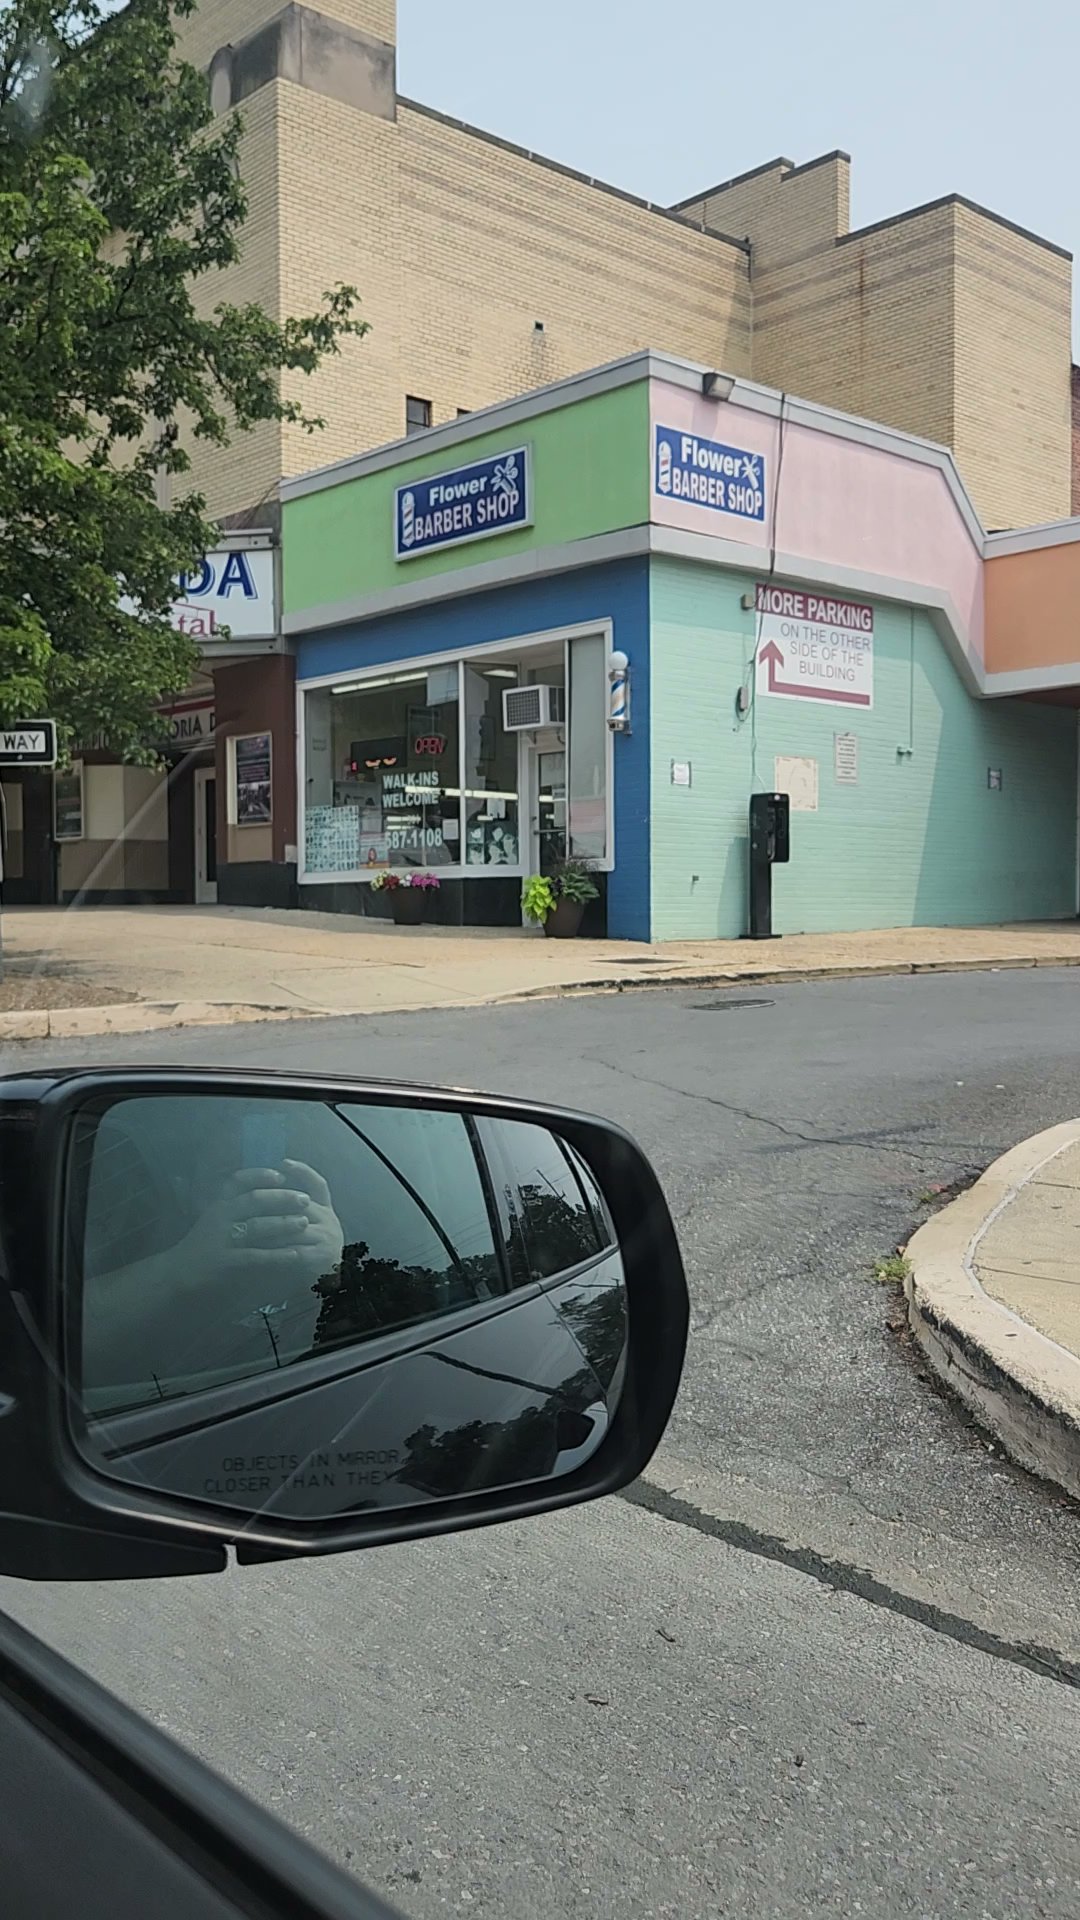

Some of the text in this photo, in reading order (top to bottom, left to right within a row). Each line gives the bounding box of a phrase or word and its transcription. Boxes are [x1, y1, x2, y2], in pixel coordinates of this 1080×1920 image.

[681, 436, 742, 478] Flower
[429, 476, 488, 507] Flower
[672, 467, 762, 516] BARBER SHOP
[415, 489, 519, 541] BARBER SHOP
[179, 552, 258, 600] DA
[758, 587, 871, 630] MORE PARKING
[177, 609, 215, 637] tal
[781, 622, 871, 651] ON THE OTHER
[790, 641, 864, 667] SIDE OF THE
[799, 660, 855, 681] BUILDING
[3, 733, 40, 750] WAY
[415, 736, 445, 754] OPEN
[382, 770, 439, 790] WALK-INS
[382, 790, 439, 809] WELCOME
[384, 827, 443, 849] 587-1108
[223, 1449, 399, 1472] OBJECTS IN MIRROR
[205, 1476, 270, 1493] CLOSER
[281, 1471, 335, 1489] THAN
